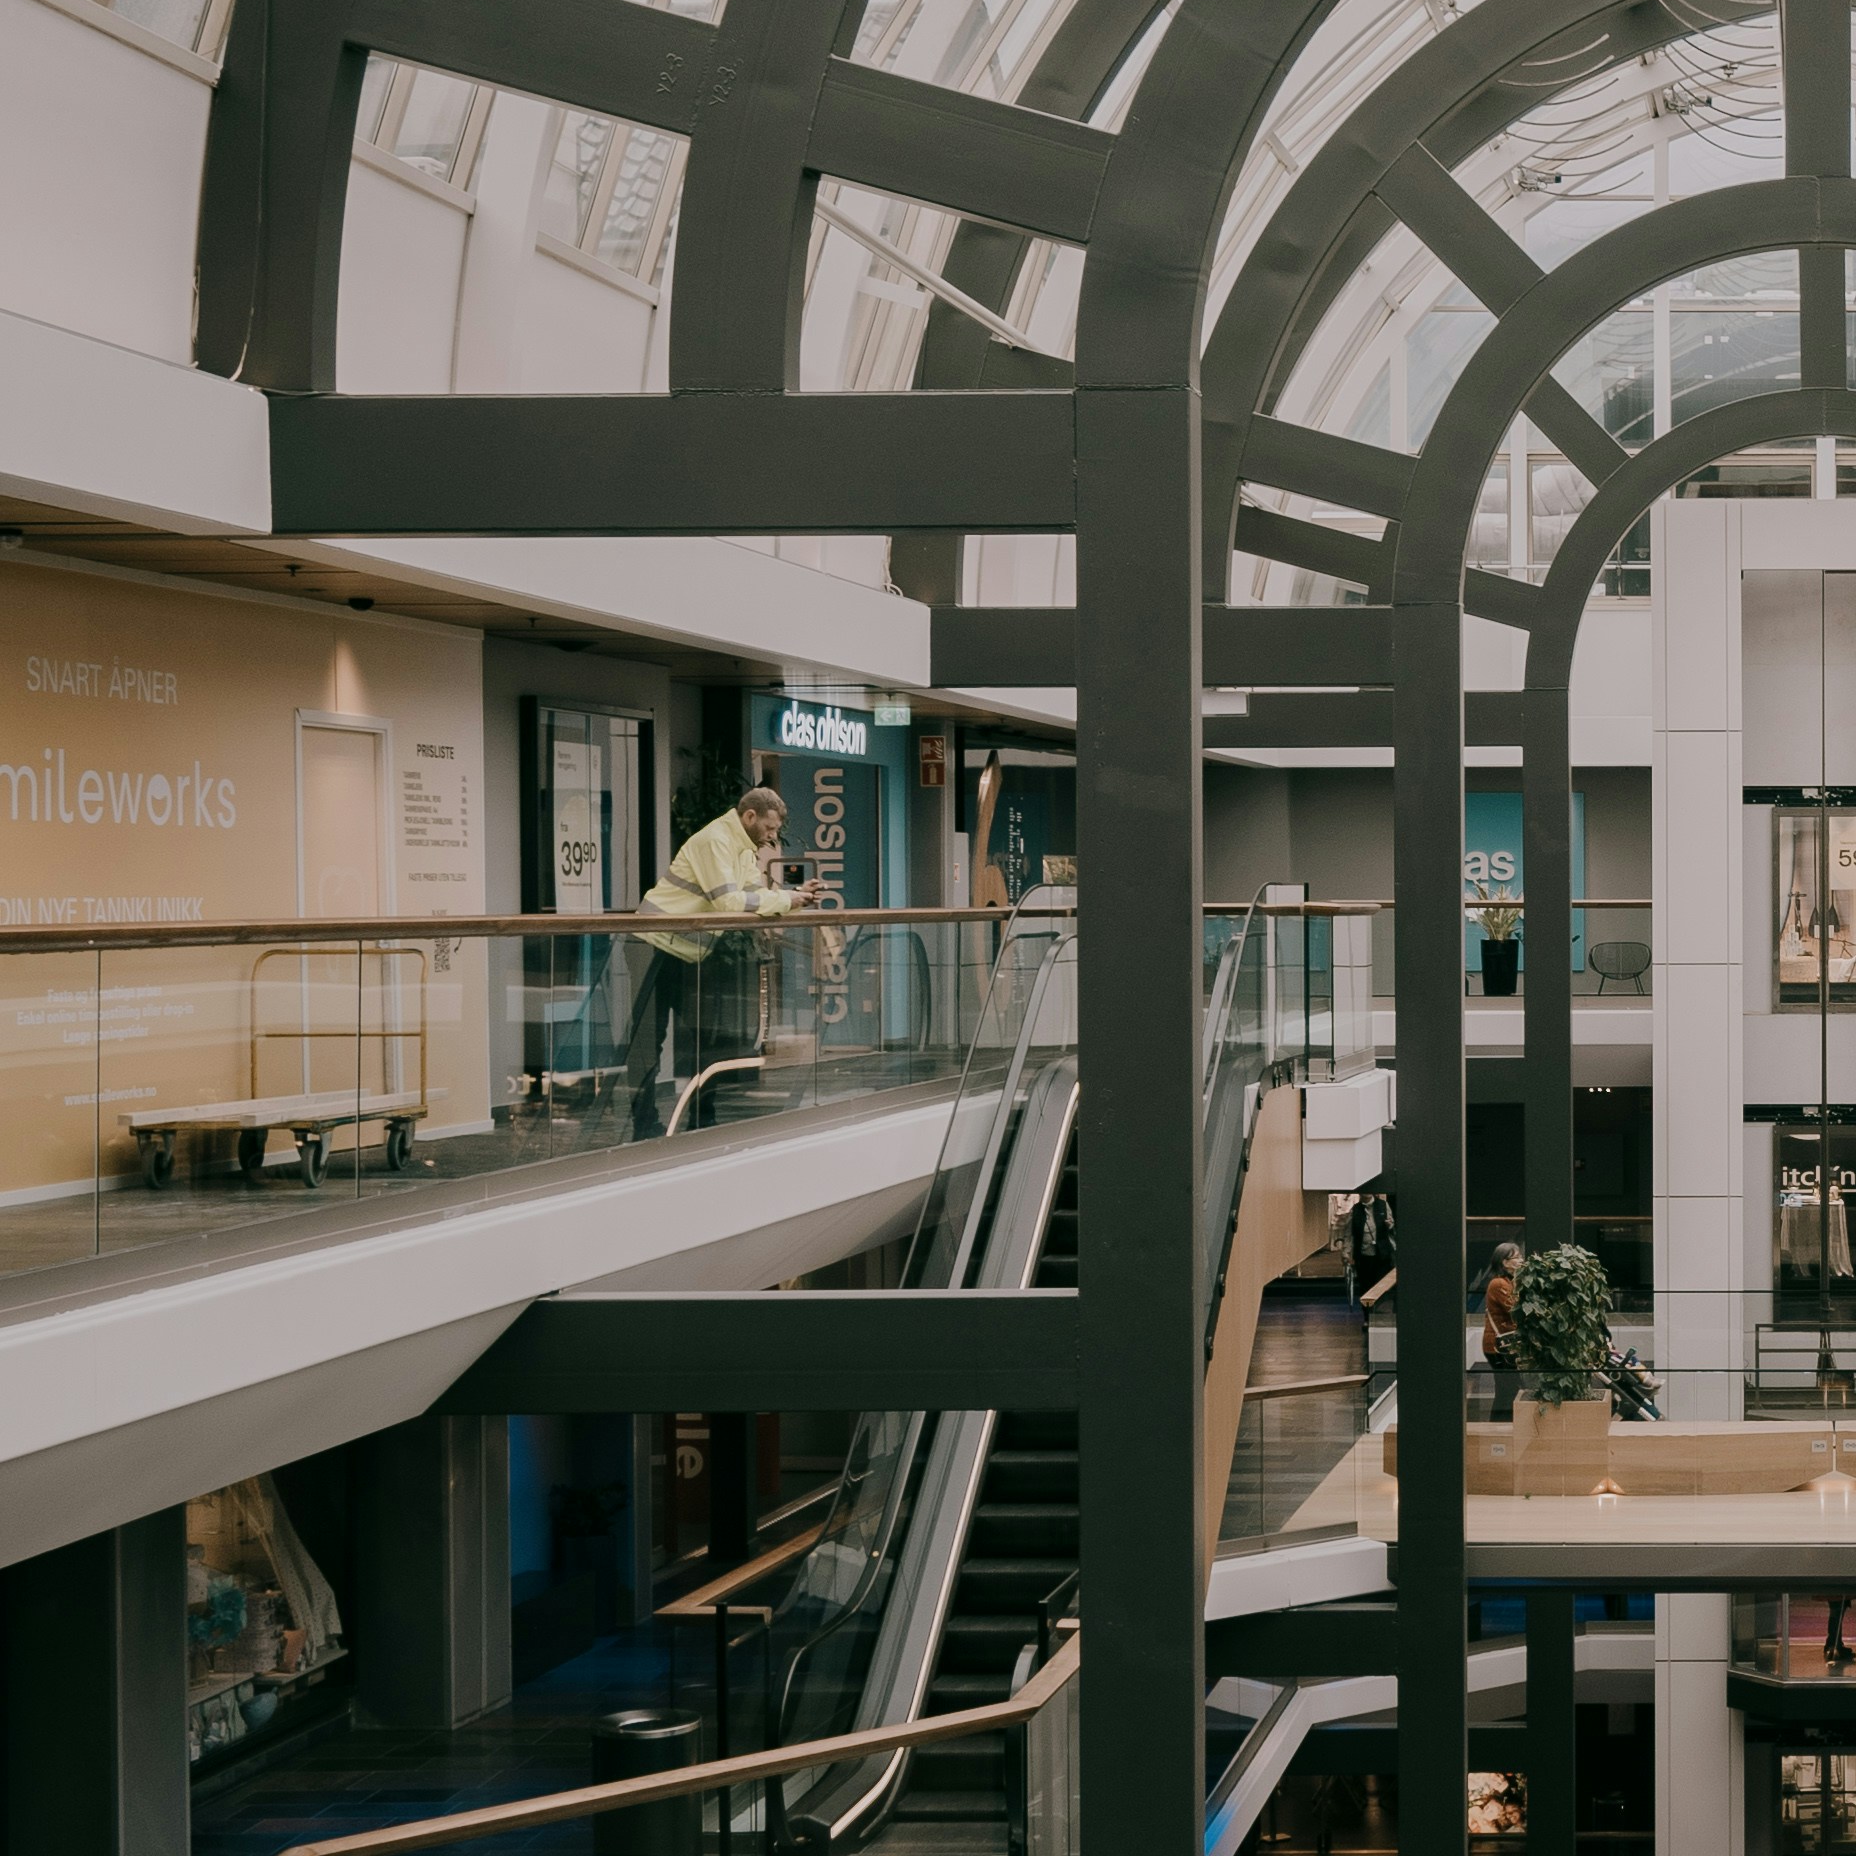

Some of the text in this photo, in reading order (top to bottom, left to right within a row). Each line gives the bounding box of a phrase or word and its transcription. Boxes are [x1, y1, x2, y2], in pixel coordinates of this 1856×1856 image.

[26, 655, 178, 705] SNART ÅPNER
[416, 743, 455, 760] PRISLISTE
[781, 700, 867, 755] clas ohlson
